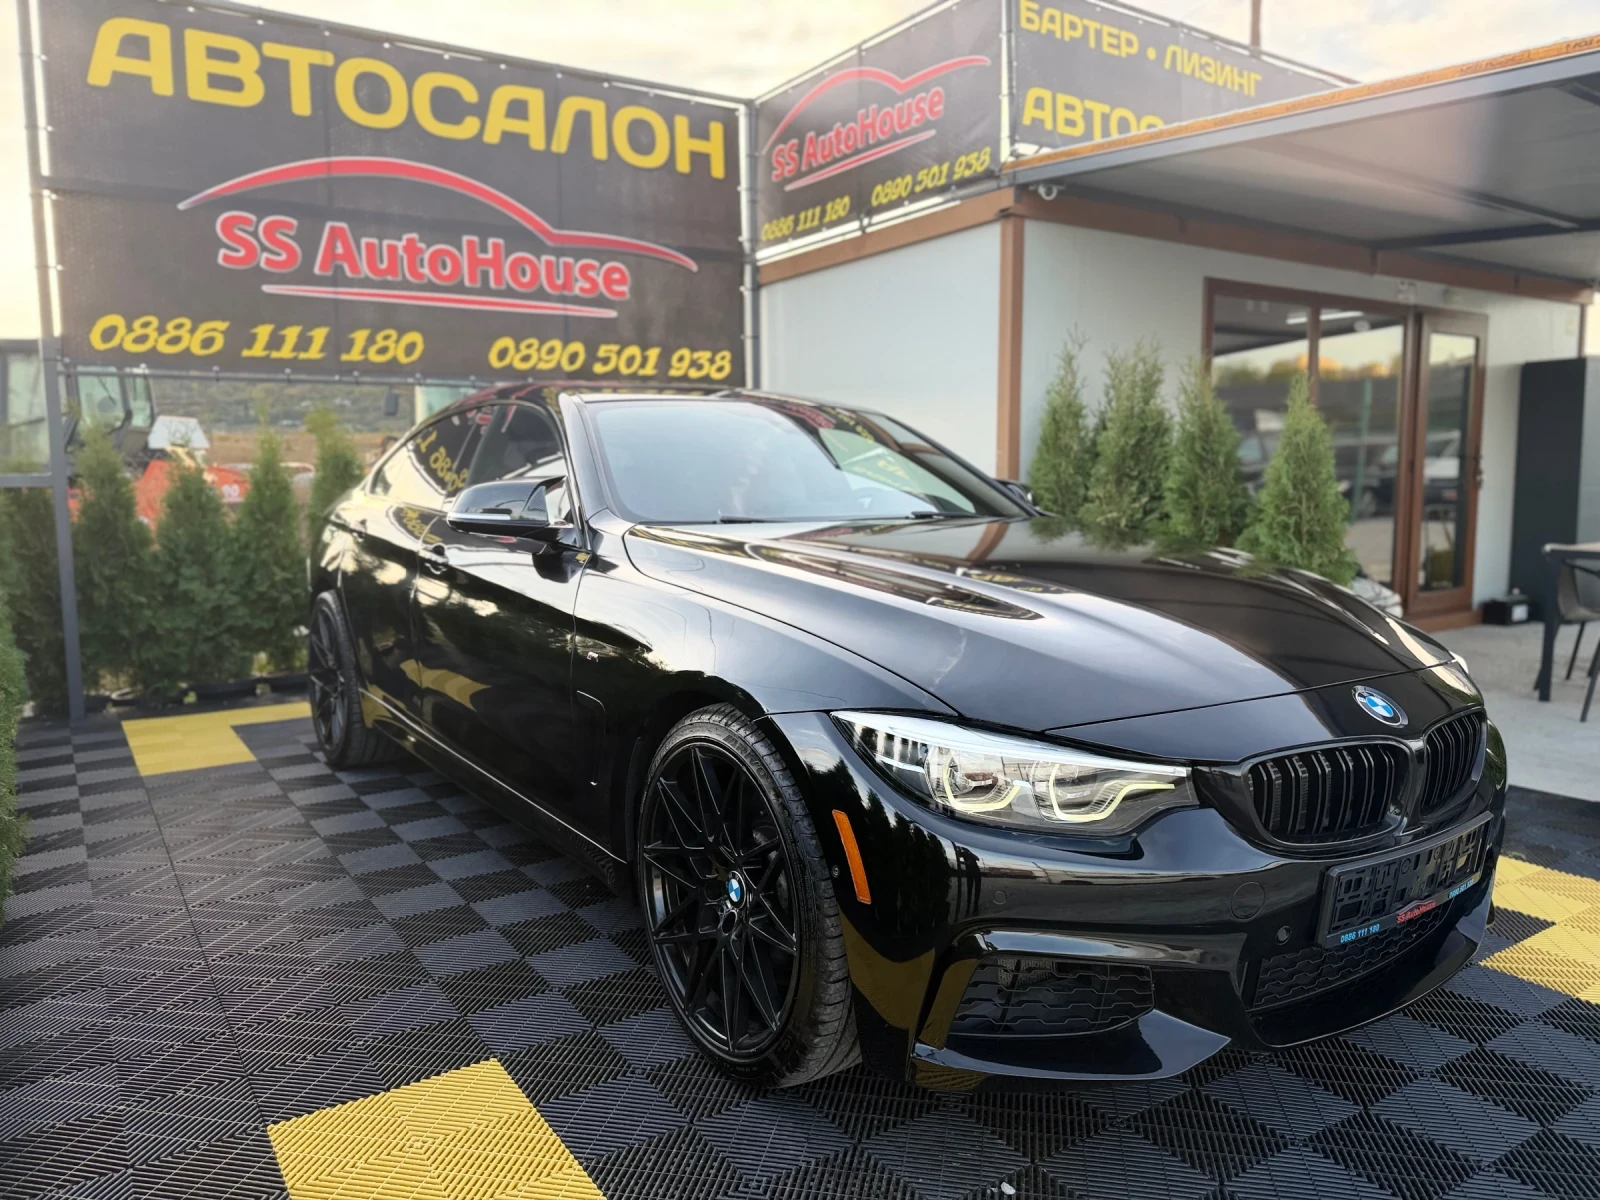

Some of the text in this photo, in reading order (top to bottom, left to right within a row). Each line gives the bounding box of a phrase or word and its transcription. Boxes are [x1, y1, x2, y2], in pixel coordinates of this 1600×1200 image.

[1019, 0, 1263, 97] БАРТЕР ЛИЗИНГ
[87, 17, 727, 181] АВТОСАЛОН
[771, 86, 946, 182] SS AutoHouse
[871, 146, 991, 207] 0890 501 938
[760, 195, 851, 242] 0886 111 180
[217, 213, 631, 300] SS AutoHouse
[89, 313, 425, 365] 0886 111 180
[488, 336, 733, 382] 0890 501 938
[1357, 927, 1368, 938] 111
